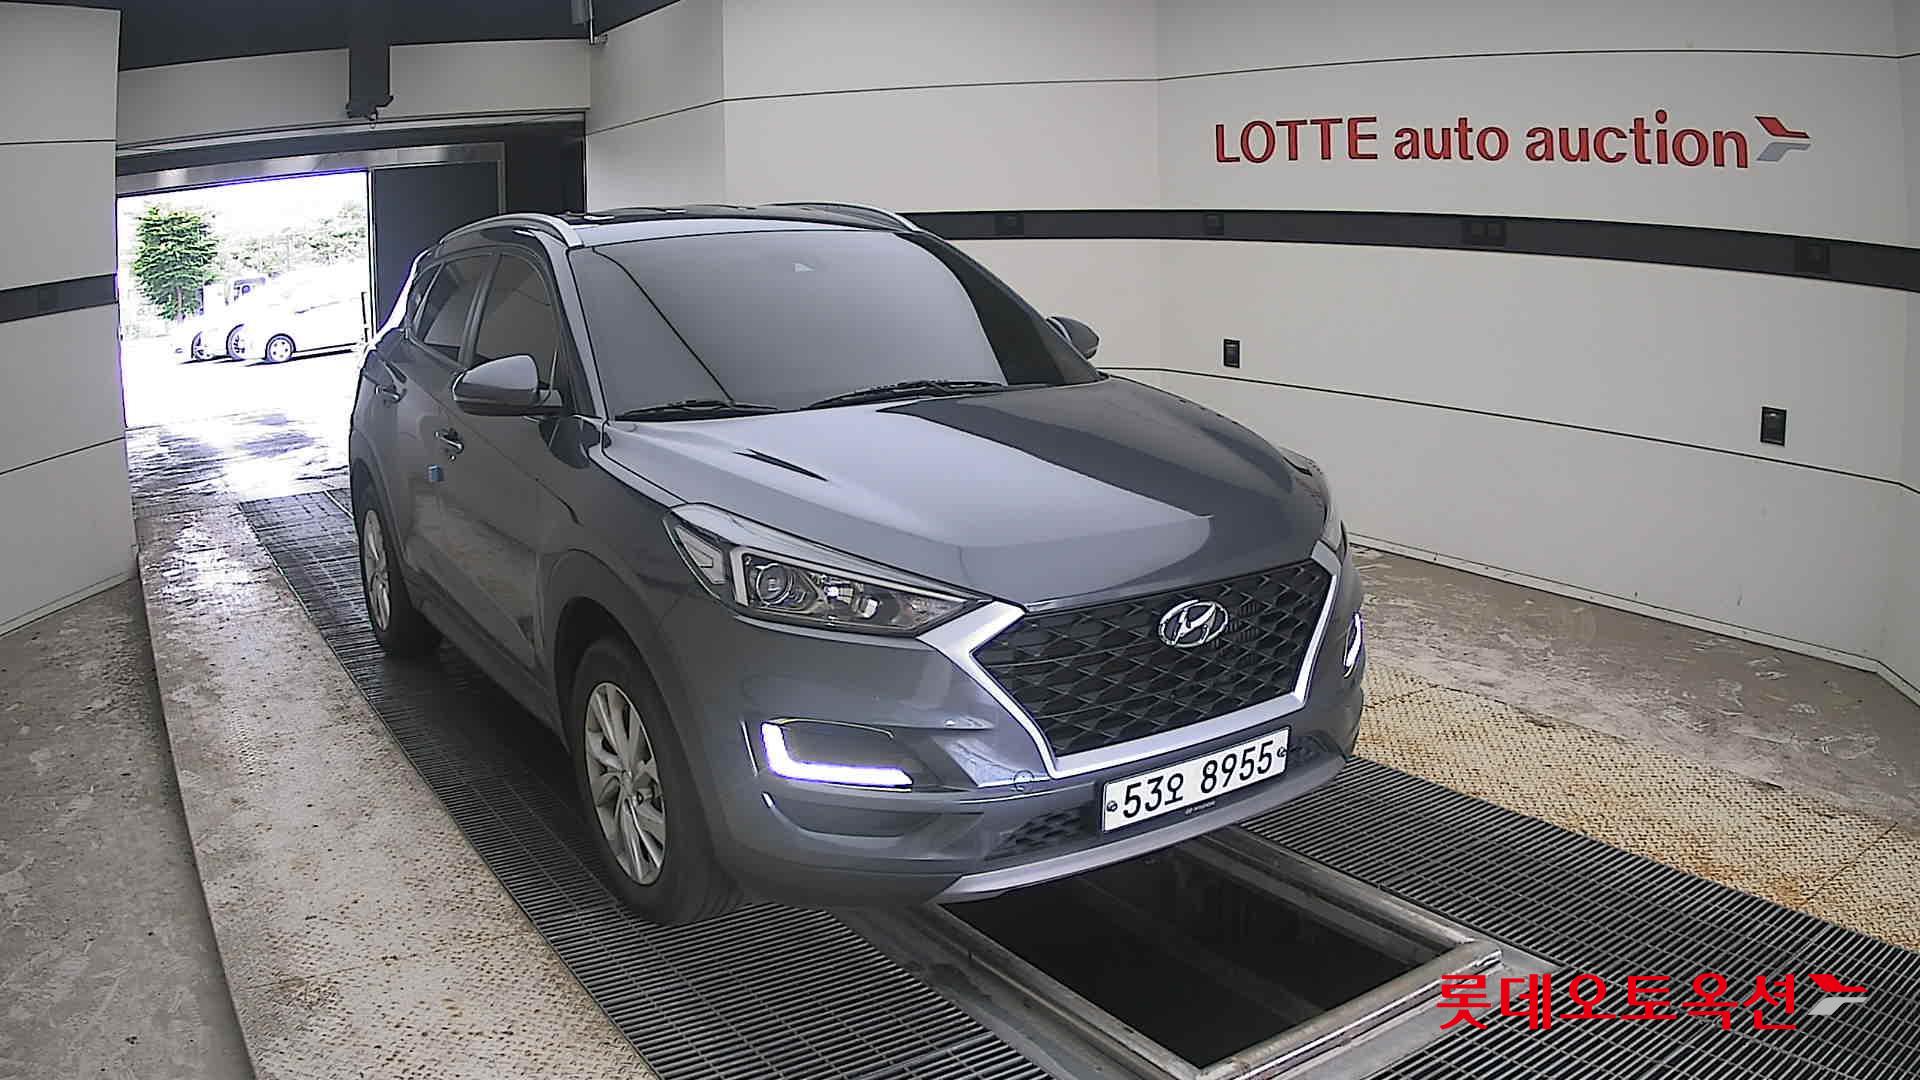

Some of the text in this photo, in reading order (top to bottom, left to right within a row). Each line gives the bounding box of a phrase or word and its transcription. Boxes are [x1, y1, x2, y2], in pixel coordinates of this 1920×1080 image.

[1215, 109, 1749, 169] LOTTE auto auction
[1123, 740, 1274, 818] 53오 8955
